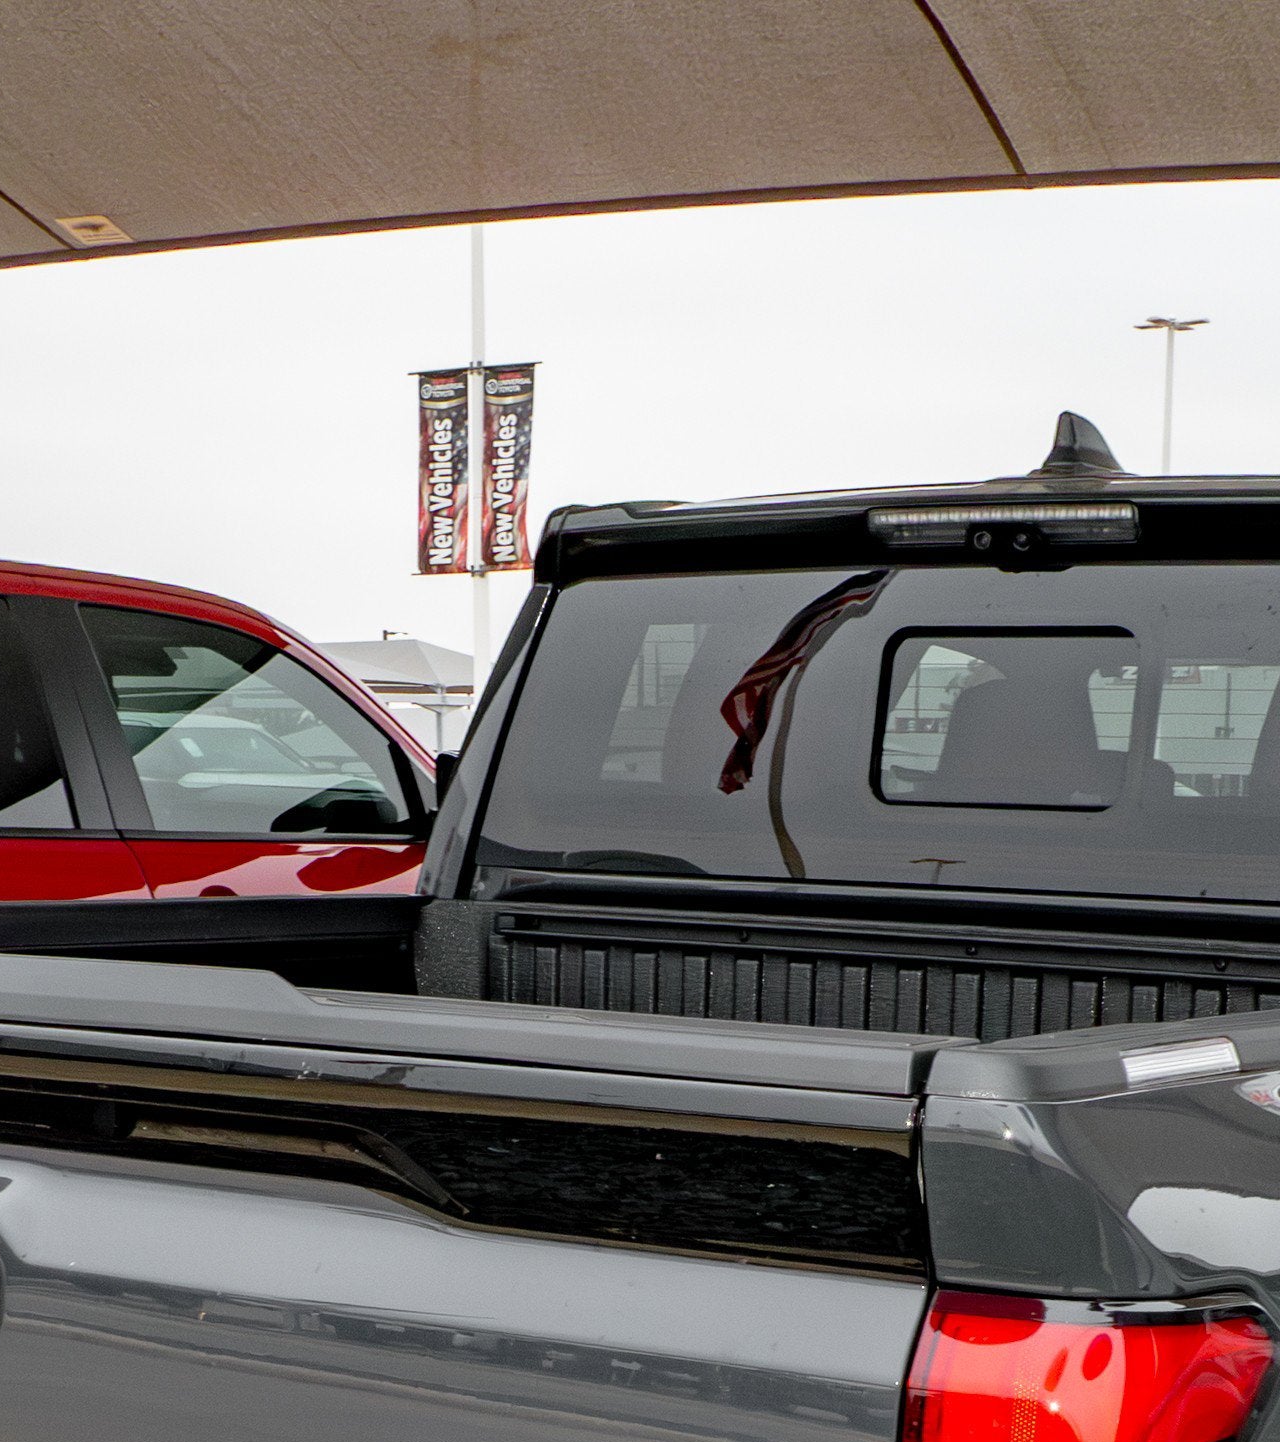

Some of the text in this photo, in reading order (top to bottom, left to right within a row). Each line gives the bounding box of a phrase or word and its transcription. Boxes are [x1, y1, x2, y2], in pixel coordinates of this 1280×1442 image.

[428, 417, 453, 565] New Vehicles
[492, 413, 518, 563] New Vehicles
